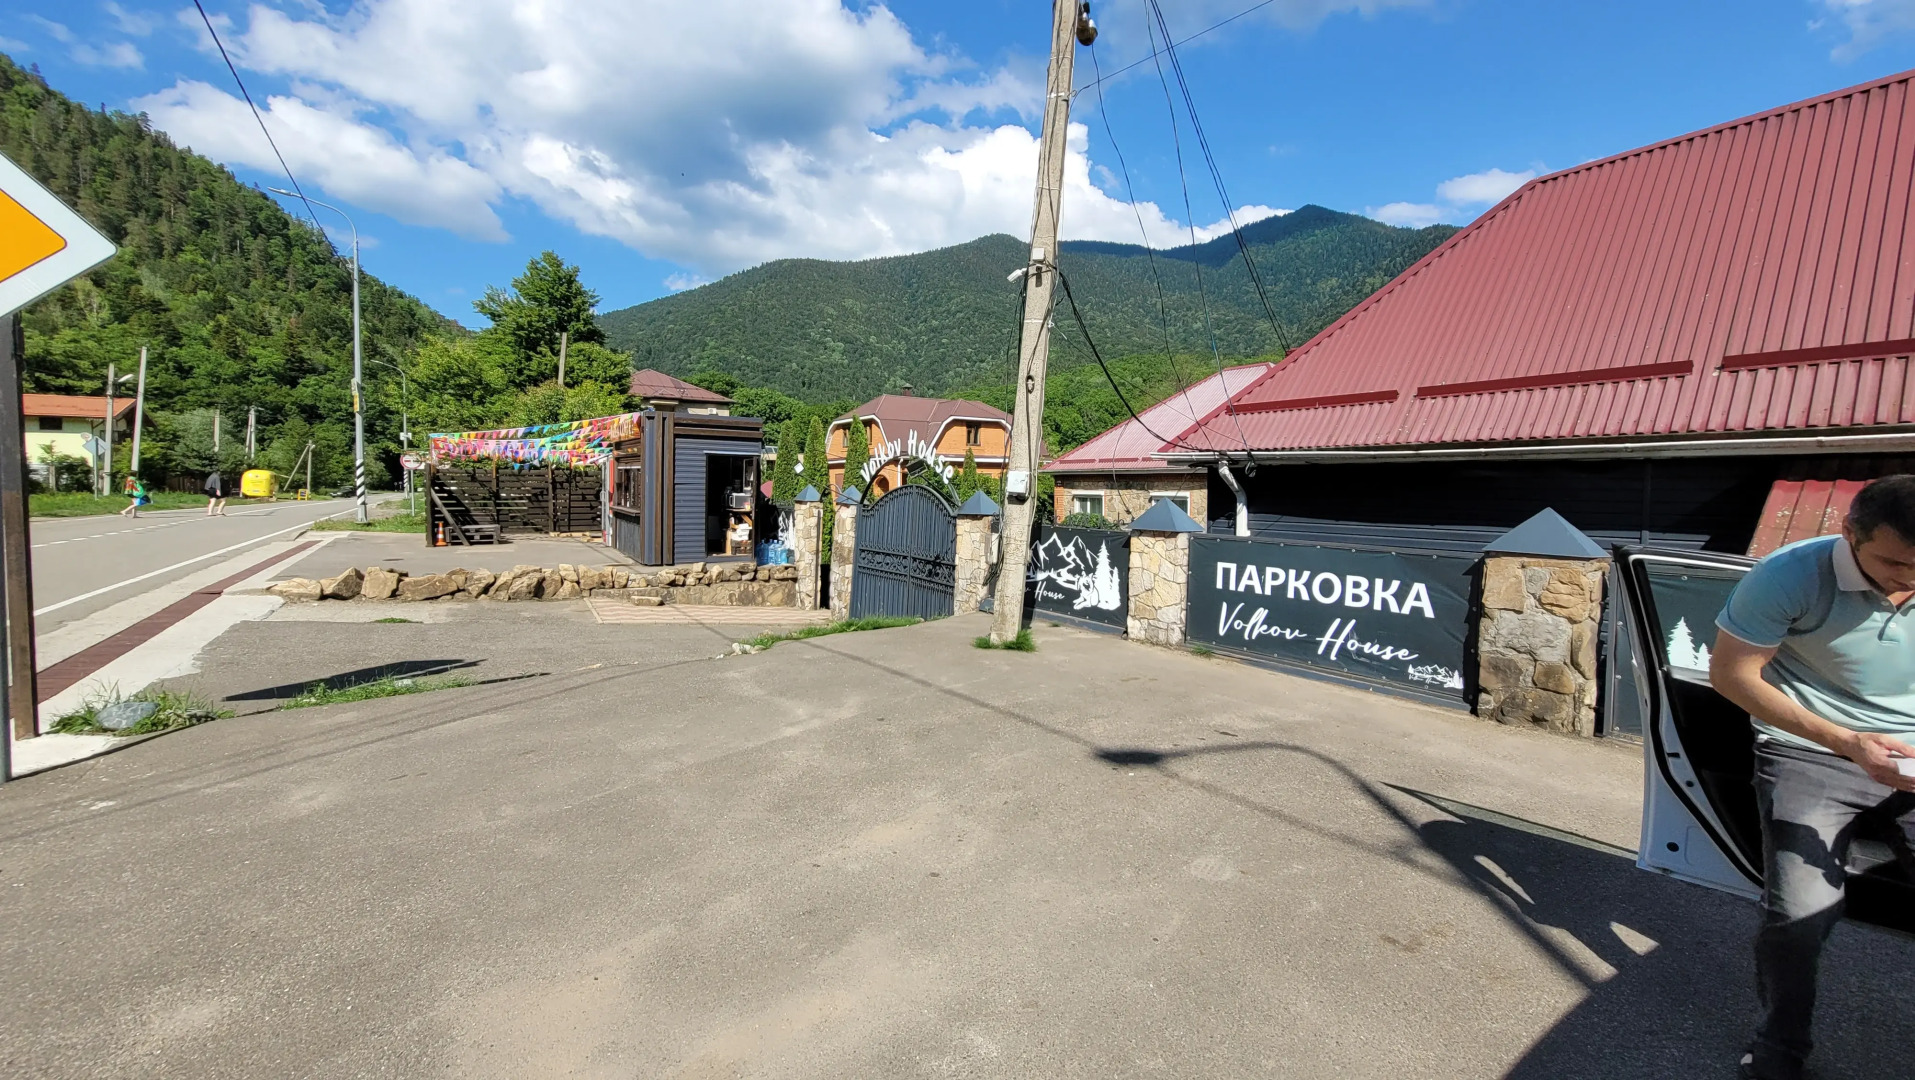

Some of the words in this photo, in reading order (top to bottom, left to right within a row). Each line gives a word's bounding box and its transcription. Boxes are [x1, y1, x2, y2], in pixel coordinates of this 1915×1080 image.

[860, 438, 901, 484] Volkov
[907, 428, 954, 485] House
[1034, 580, 1066, 602] House
[1216, 561, 1435, 619] ПАРКОВКА
[1218, 601, 1307, 641] Volkov
[1316, 617, 1419, 661] House
